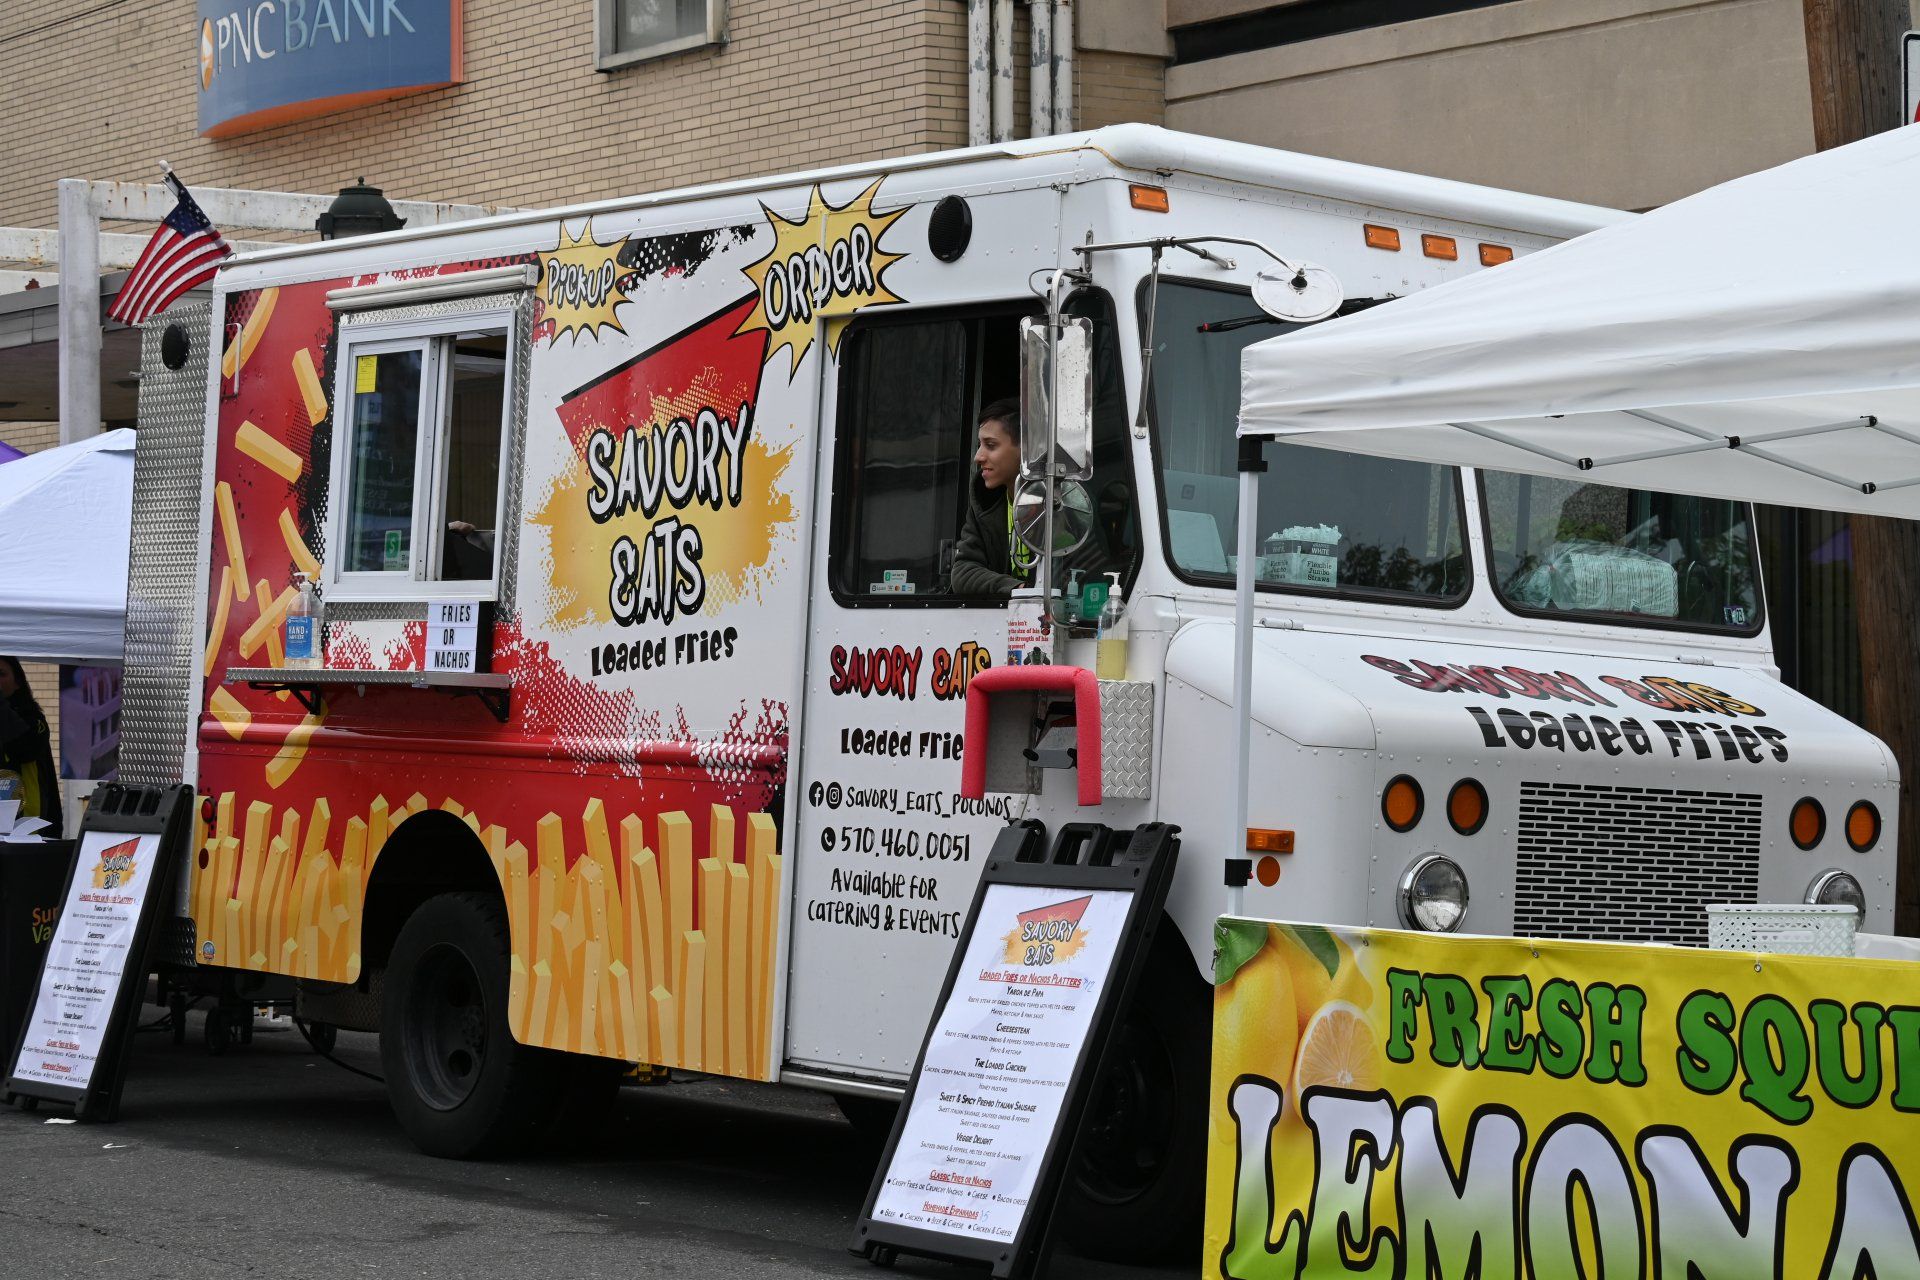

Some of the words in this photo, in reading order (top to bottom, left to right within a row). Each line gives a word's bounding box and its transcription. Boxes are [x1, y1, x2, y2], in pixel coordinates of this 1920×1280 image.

[216, 2, 276, 74] PNC
[284, 0, 416, 53] BANK
[548, 258, 615, 310] PICKUP
[764, 223, 876, 331] ORDER
[587, 401, 750, 524] SAVORY
[609, 515, 705, 627] EATS
[1308, 568, 1330, 576] Jumbo
[1308, 574, 1330, 582] Straws
[442, 606, 471, 622] FRIES
[443, 629, 454, 645] OR
[434, 652, 470, 670] NACHOS
[591, 637, 666, 676] Loaded
[675, 626, 738, 665] Fries
[830, 645, 922, 701] SAVORY
[1360, 654, 1618, 708] SAVORY
[1599, 674, 1767, 718] EATS
[841, 728, 911, 758] Loaded
[920, 732, 963, 760] Frie
[1465, 706, 1652, 756] Loaded
[1652, 719, 1788, 763] Fries
[842, 826, 970, 861] 570.460.0051
[830, 868, 905, 899] Available
[884, 905, 895, 931] &
[1022, 920, 1078, 942] SAVORY
[1024, 942, 1054, 966] EATS
[979, 969, 1001, 980] LOADED
[1002, 970, 1018, 982] FRIES
[1020, 974, 1028, 982] OR
[1028, 972, 1051, 984] NACHOS
[1052, 974, 1082, 986] PLATTERS
[996, 1023, 1030, 1034] CHEESESTEAK
[1386, 966, 1647, 1088] FRESH
[975, 1058, 984, 1067] THE
[985, 1060, 1004, 1070] LOADED
[1006, 1062, 1027, 1072] CHICKEN
[940, 1092, 956, 1102] SWEET
[956, 1094, 961, 1102] &
[962, 1095, 976, 1105] SPICY
[977, 1097, 994, 1107] PREMIO
[995, 1099, 1014, 1110] ITALIAN
[1014, 1101, 1037, 1112] SAUSAGE
[956, 1132, 973, 1143] VEGGIE
[973, 1134, 993, 1145] DELIGHT
[930, 1170, 950, 1181] CLASSIC
[951, 1172, 964, 1183] FRIES
[972, 1176, 992, 1186] NACHOS
